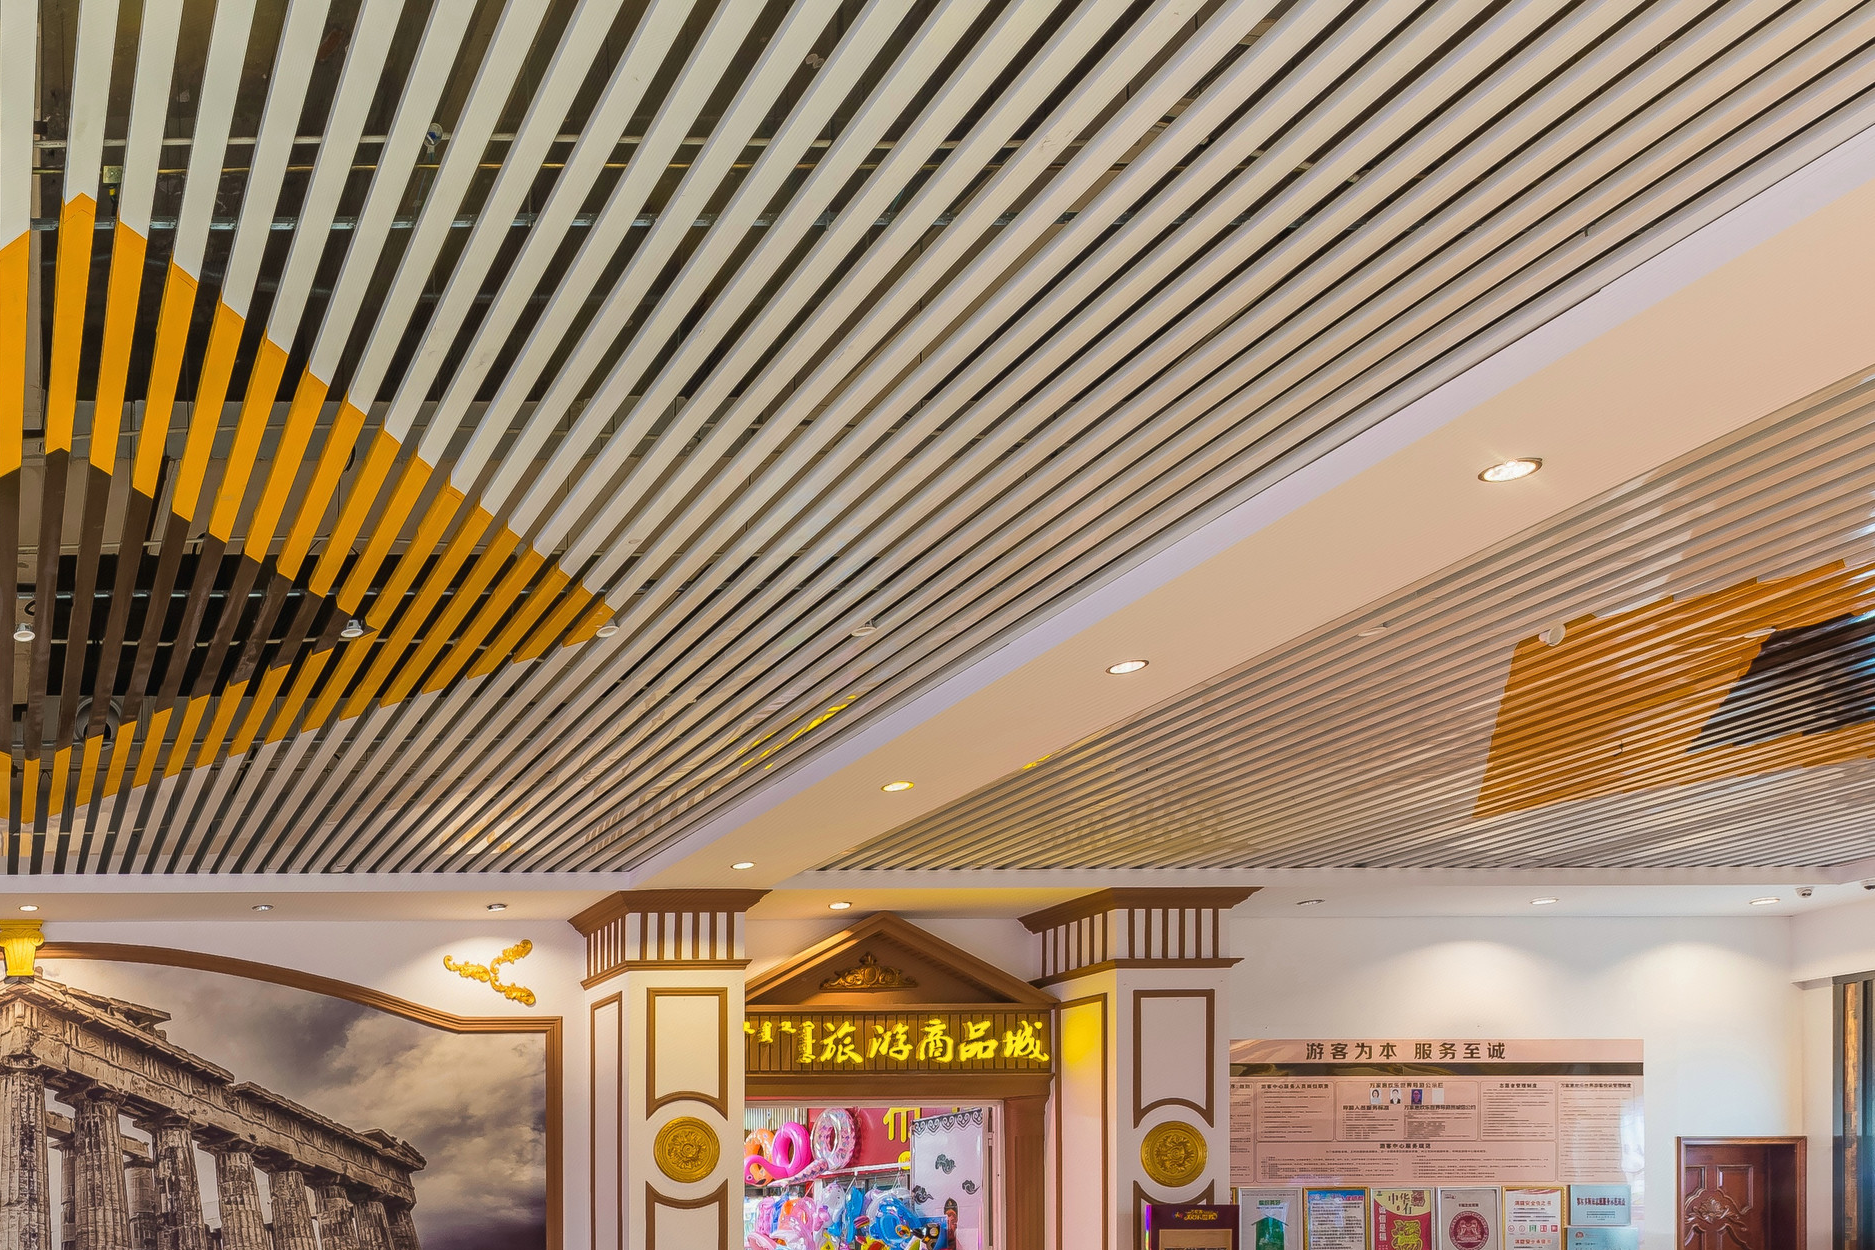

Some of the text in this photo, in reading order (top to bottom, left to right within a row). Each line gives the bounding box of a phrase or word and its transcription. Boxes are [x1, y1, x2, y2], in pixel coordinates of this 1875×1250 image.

[821, 1019, 1049, 1063] 旅游商品城
[1306, 1042, 1505, 1060] 游客为本 服务至诚
